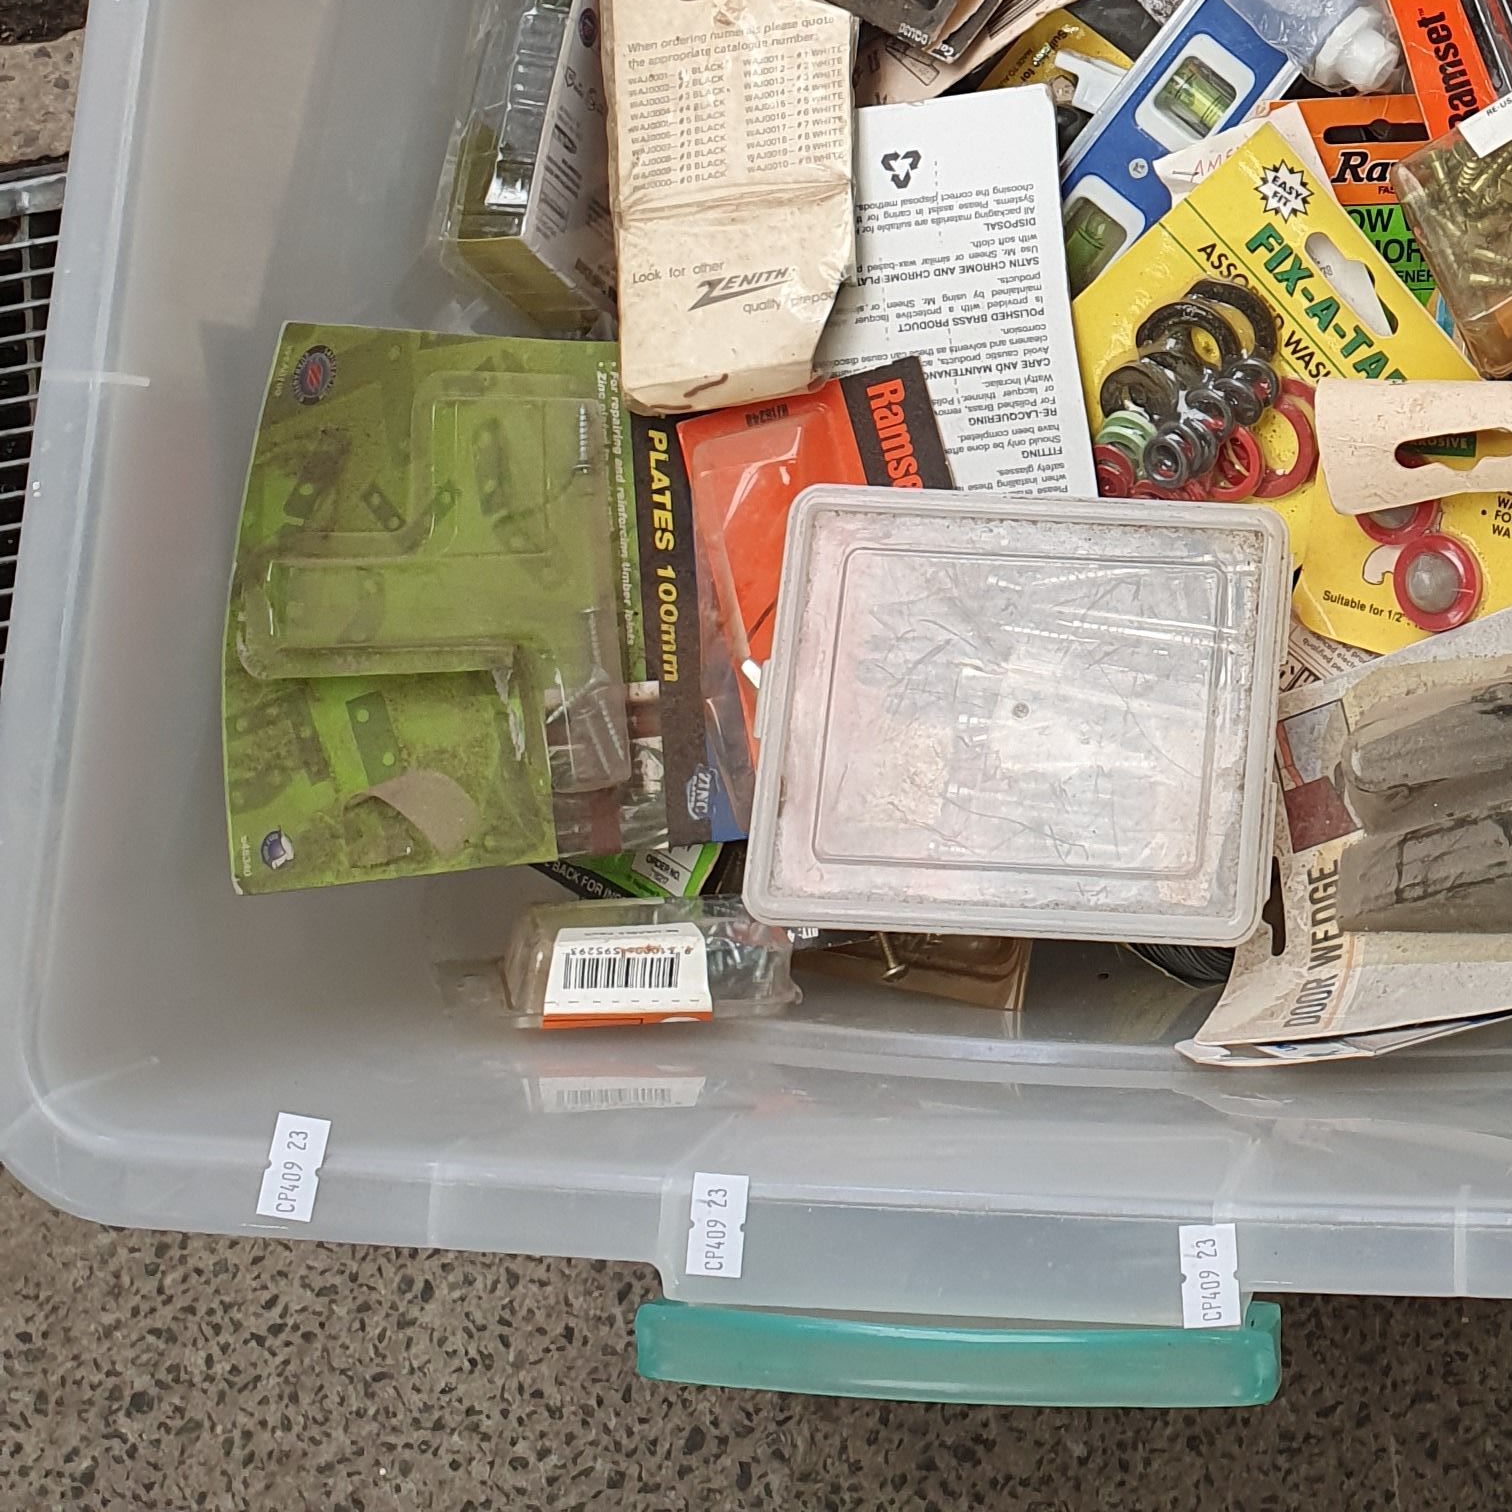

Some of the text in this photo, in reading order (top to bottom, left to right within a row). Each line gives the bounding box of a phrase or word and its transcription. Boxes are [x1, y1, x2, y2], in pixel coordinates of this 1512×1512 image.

[628, 18, 798, 54] When ordering please
[628, 47, 712, 69] the appropriate
[692, 63, 724, 75] BLACK
[695, 123, 726, 135] BLACK
[695, 171, 727, 183] BLACK
[993, 184, 1034, 194] choosing
[1271, 174, 1303, 202] EASY
[962, 199, 988, 209] Please
[1271, 189, 1292, 208] FIT
[975, 208, 1021, 219] packaging
[984, 218, 1036, 231] DISPOSAL
[1019, 233, 1038, 242] with
[633, 261, 725, 284] Look for other
[884, 256, 1039, 283] SATIN CHROME AND CHROME
[688, 267, 793, 312] ZENITH
[1245, 222, 1408, 381] FIX-A-TA
[743, 299, 782, 315] quality
[898, 307, 1044, 332] POLISHED BRASS PRODUCT
[996, 358, 1050, 372] CARE AND
[597, 371, 607, 399] Zinc
[968, 407, 1057, 426] RE-LACQUERING
[1021, 446, 1063, 459] FITTING
[609, 371, 634, 646] For repairing timber joints
[647, 429, 680, 682] PLATES 100mm
[1322, 590, 1384, 617] Suitable for
[551, 861, 603, 895] BACK FOR
[1283, 859, 1340, 1029] DOOR WEDGE
[276, 1130, 309, 1214] CP409 23
[705, 1187, 728, 1271] CP409 23
[1196, 1238, 1222, 1322] CP409 23
